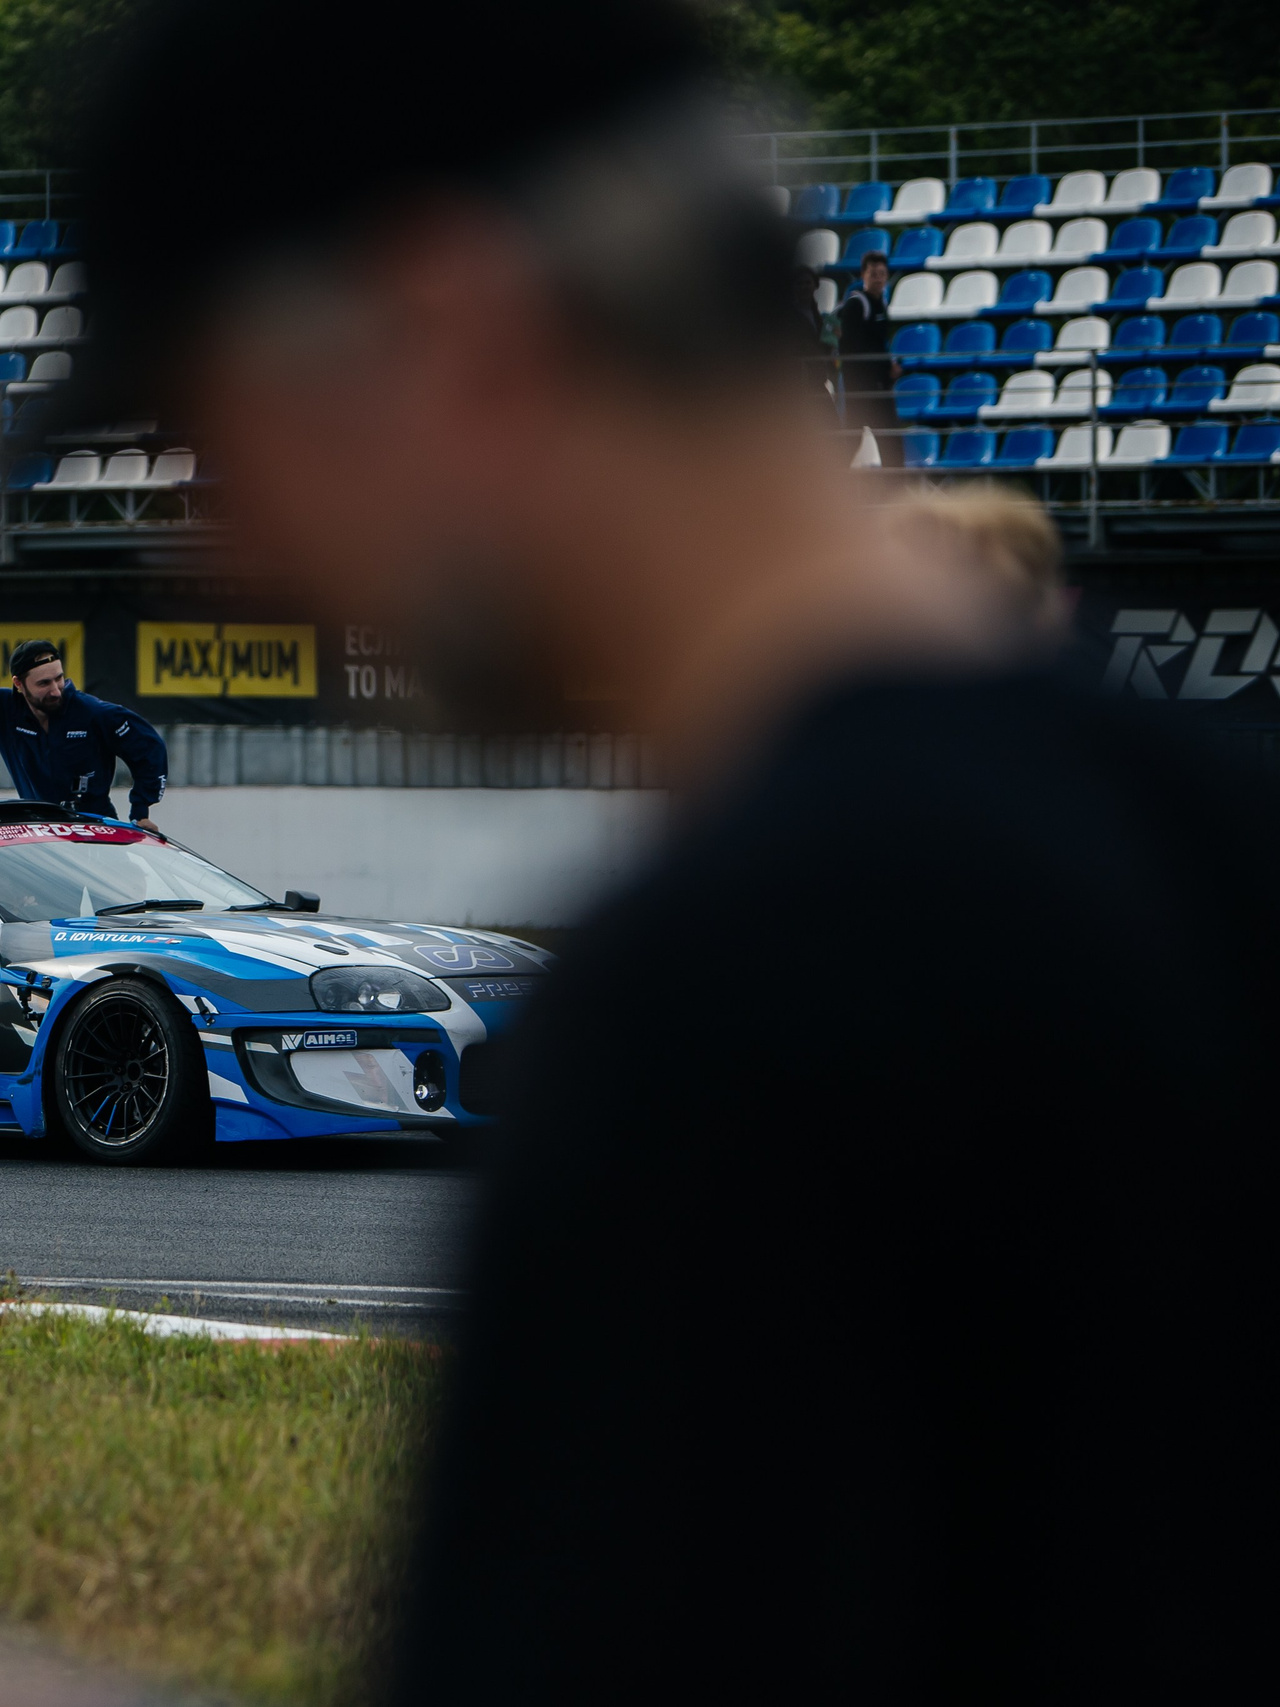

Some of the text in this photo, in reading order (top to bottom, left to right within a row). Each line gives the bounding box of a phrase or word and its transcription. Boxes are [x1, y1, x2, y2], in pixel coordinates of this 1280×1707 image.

[1102, 608, 1280, 700] RD
[27, 824, 95, 836] RDS
[54, 932, 146, 943] D. IDIYATULIN
[306, 1034, 354, 1044] AIMOL
